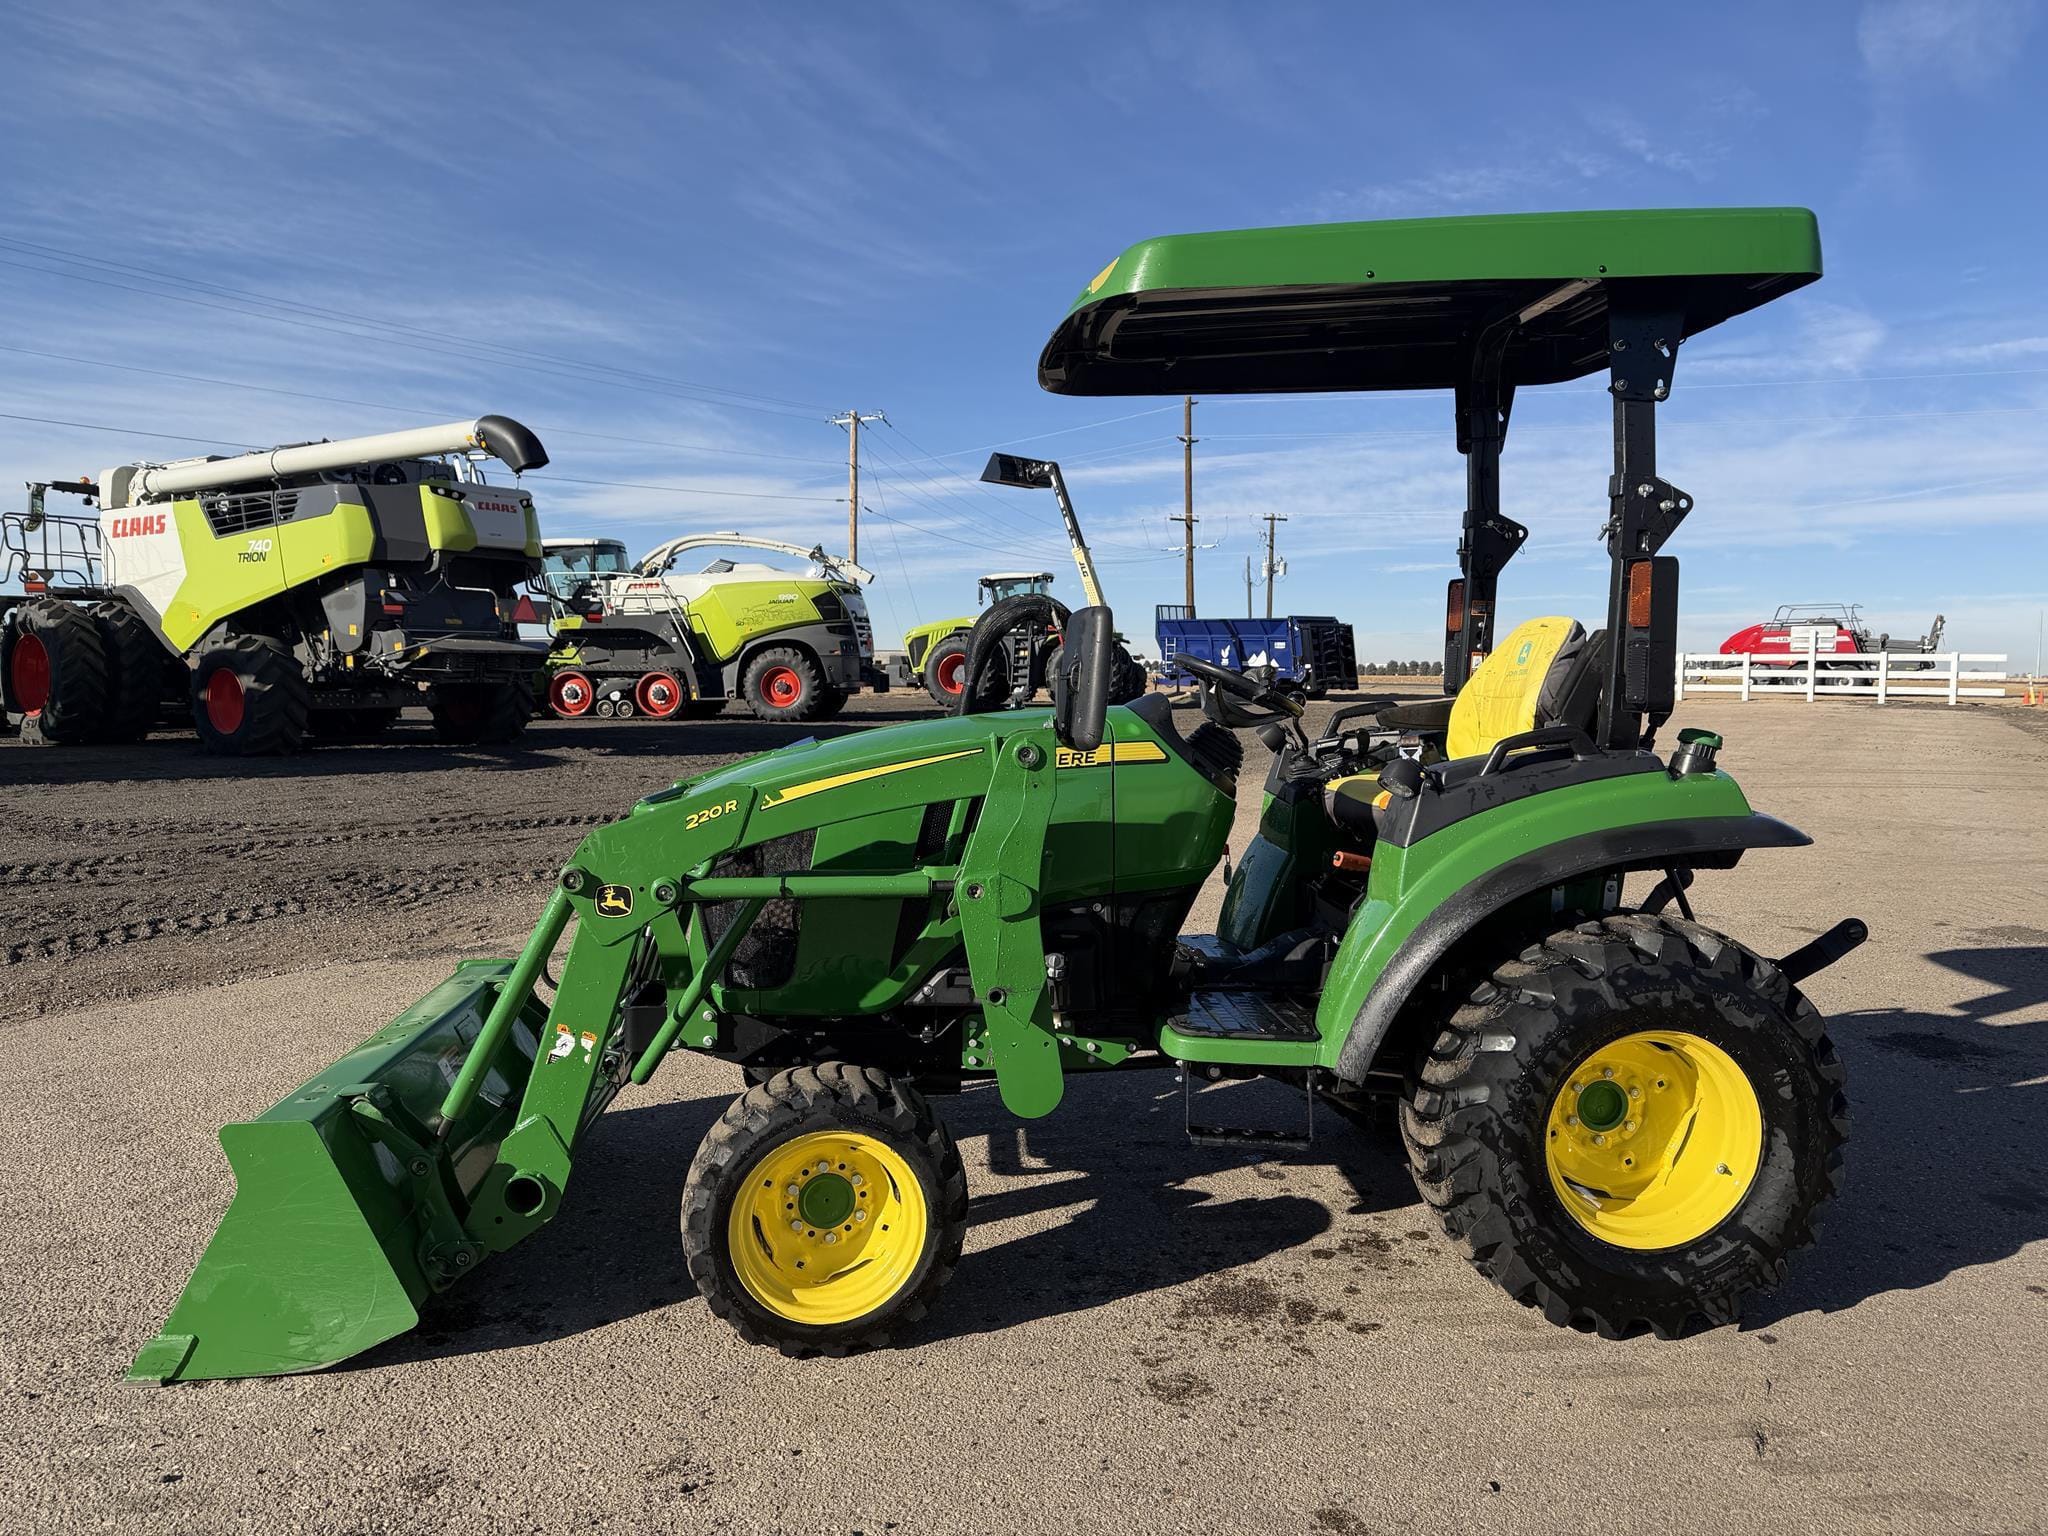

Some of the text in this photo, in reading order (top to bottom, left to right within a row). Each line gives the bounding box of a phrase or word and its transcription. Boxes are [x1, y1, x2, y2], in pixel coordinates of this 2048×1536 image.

[478, 502, 517, 513] CLAAS
[112, 514, 166, 538] CLAAS
[248, 539, 272, 552] 740
[238, 552, 267, 563] TRION
[1079, 561, 1089, 577] JLG
[1056, 752, 1096, 766] ERE
